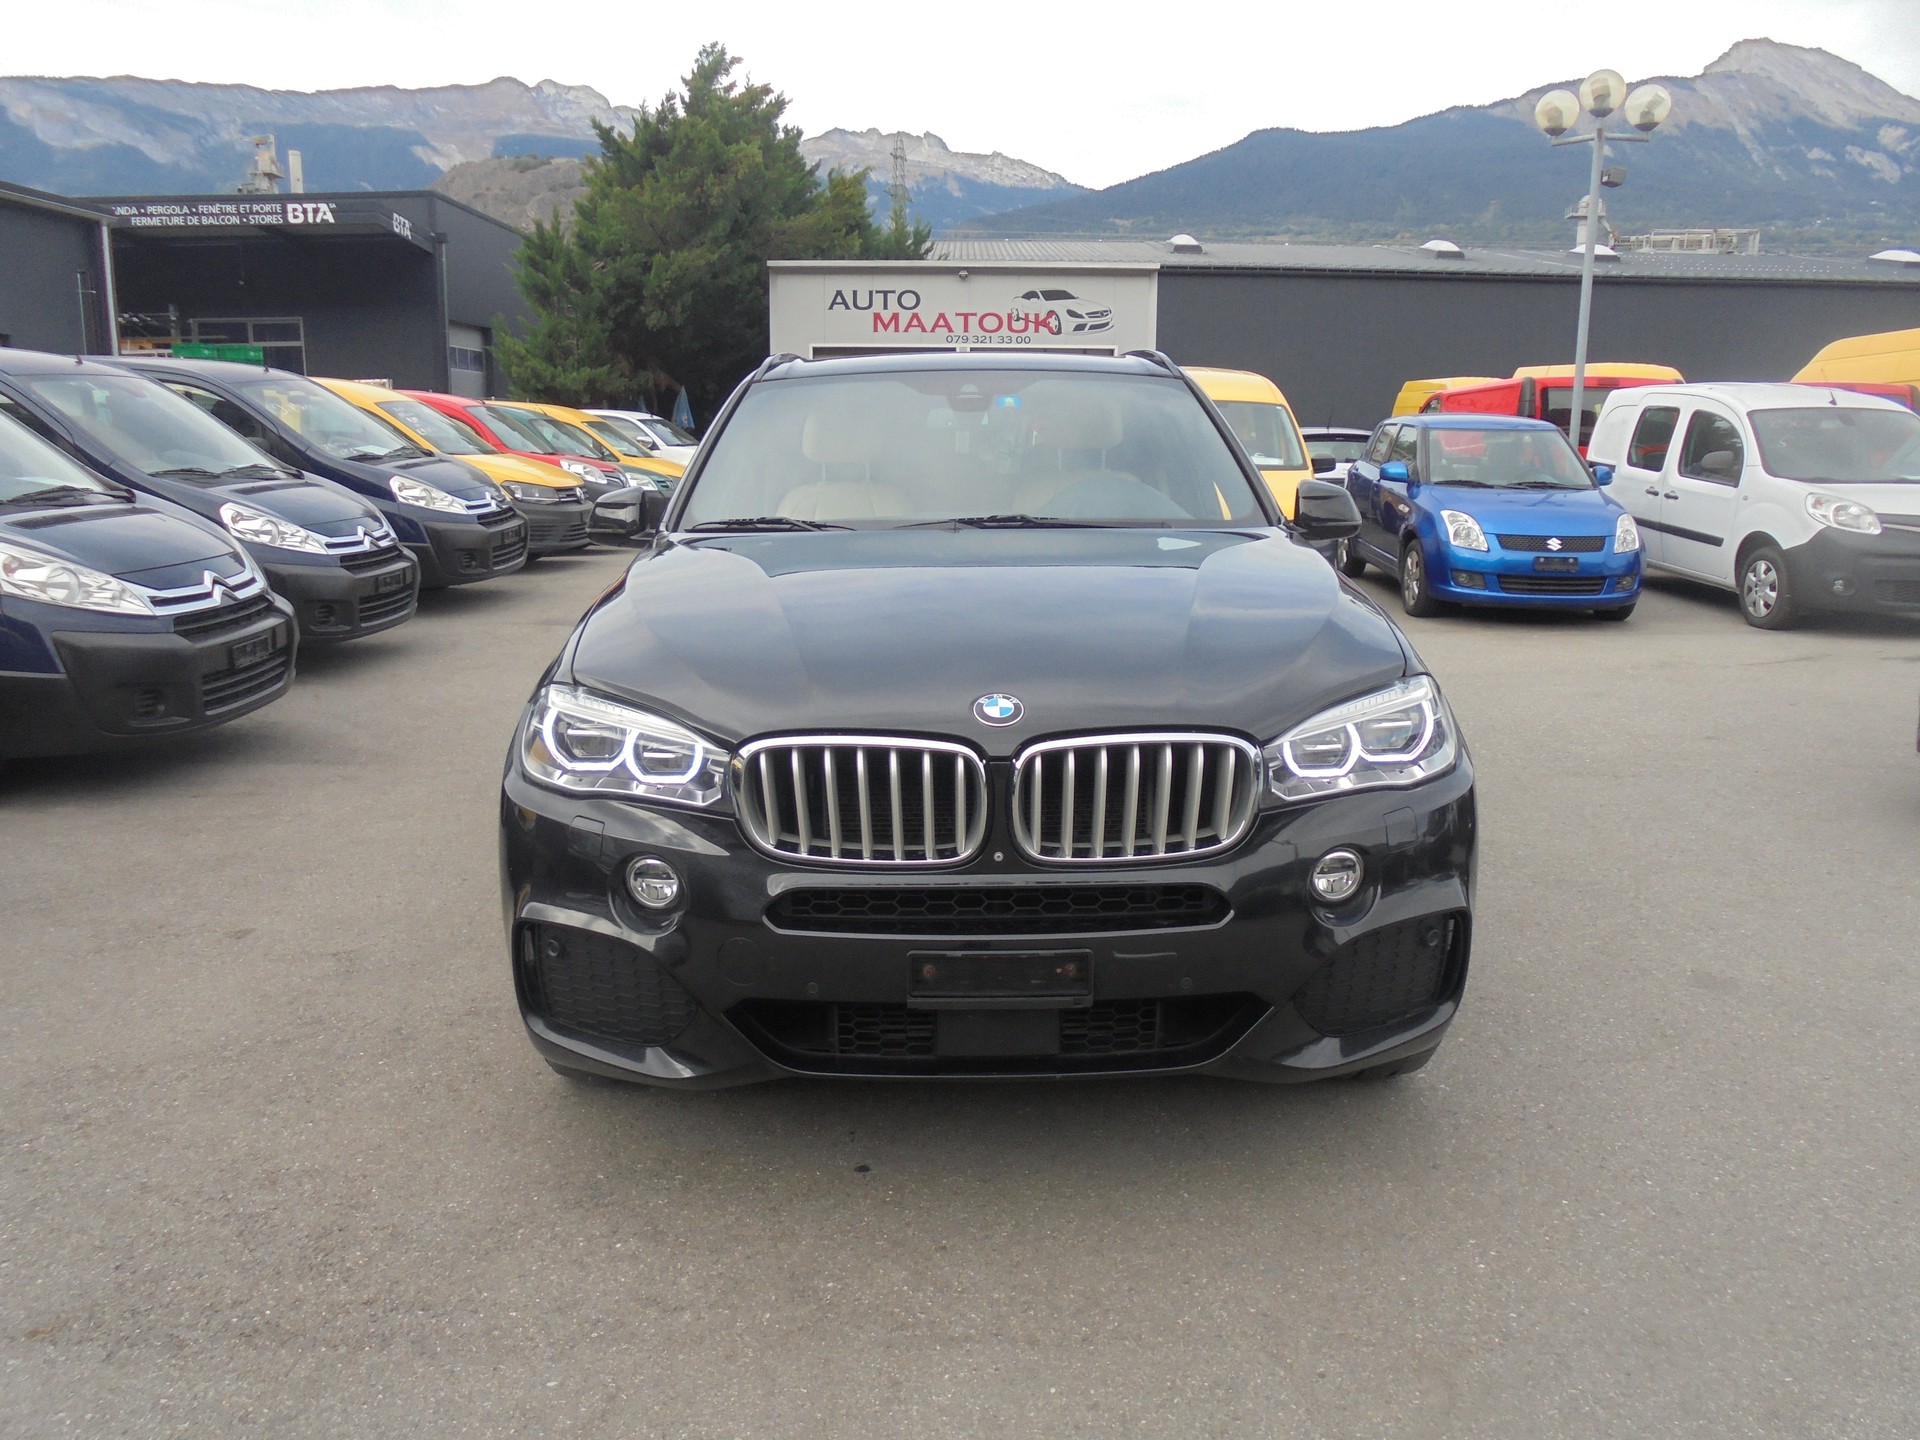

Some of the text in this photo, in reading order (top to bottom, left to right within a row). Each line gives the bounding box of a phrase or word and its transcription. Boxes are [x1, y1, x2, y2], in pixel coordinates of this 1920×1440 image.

[147, 205, 189, 215] PERGOLA
[199, 203, 237, 214] FENÊTRE
[240, 204, 250, 213] ET
[253, 203, 282, 213] PORTE
[286, 203, 335, 224] BTA
[131, 214, 283, 226] FERMETURE DE BALCON STORES
[393, 212, 411, 240] BTA
[828, 289, 921, 311] AUTO
[872, 312, 1055, 334] MAATOUK
[946, 335, 1031, 344] 079 321 33 00
